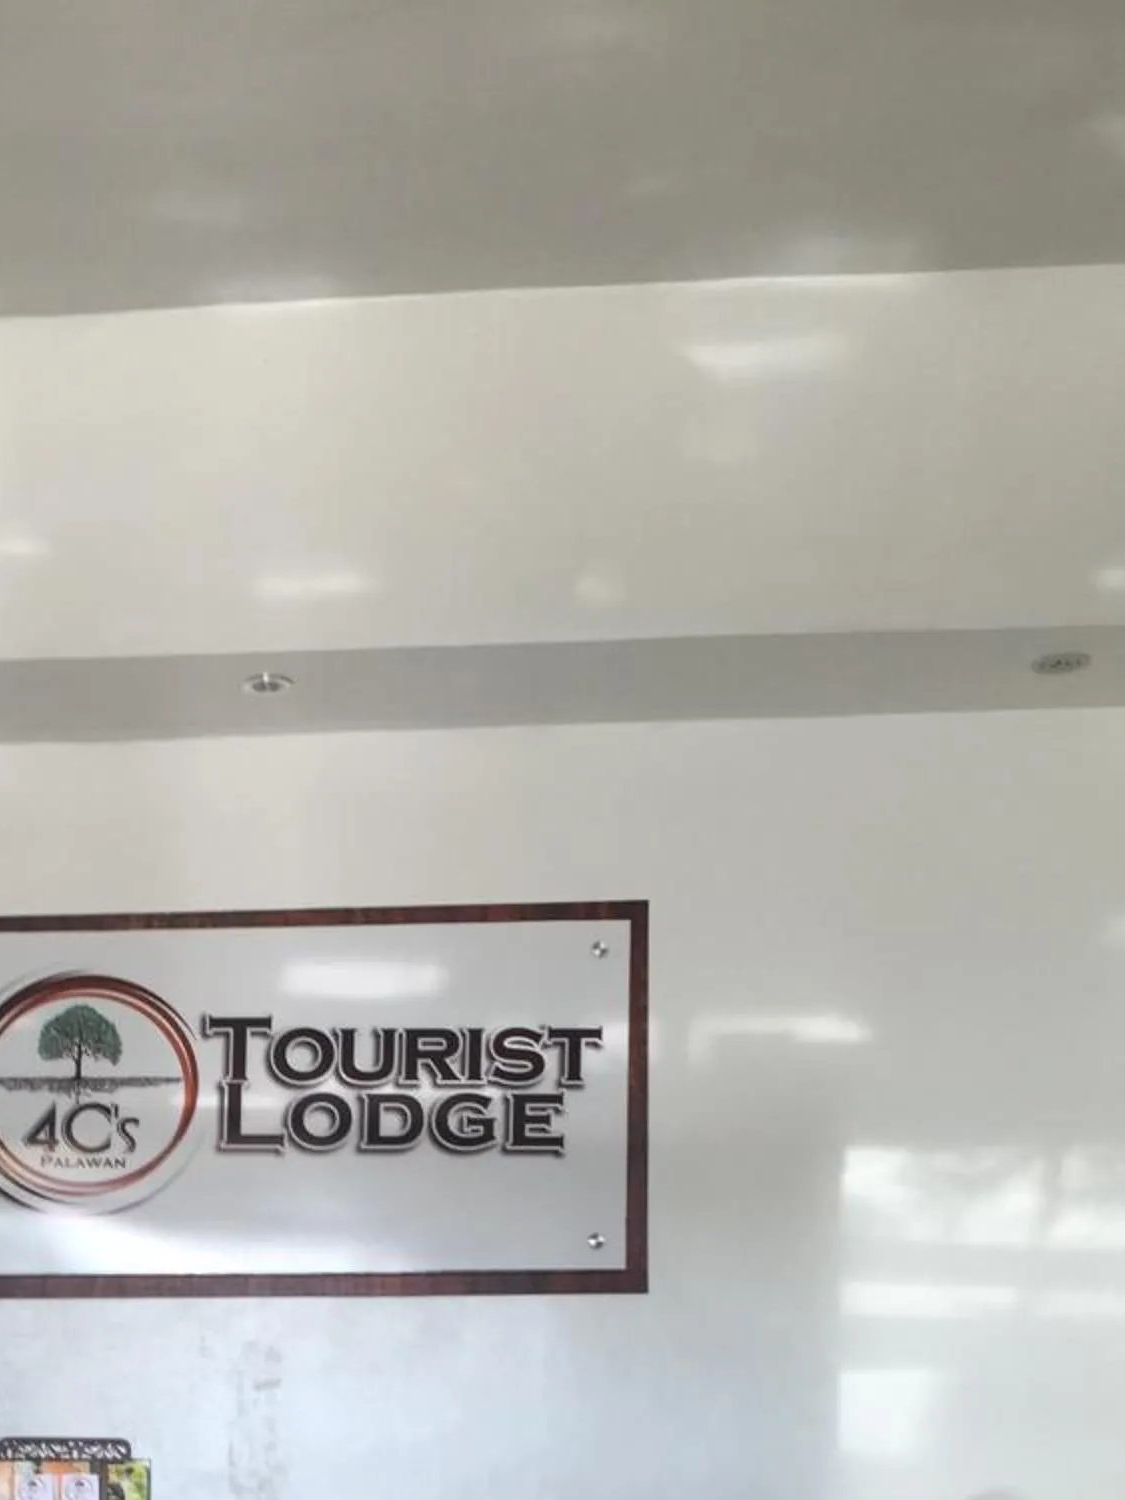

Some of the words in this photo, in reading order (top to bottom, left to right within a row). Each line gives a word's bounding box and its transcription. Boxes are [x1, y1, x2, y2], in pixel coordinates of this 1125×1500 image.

[205, 1014, 603, 1087] TOURIST
[23, 1100, 140, 1152] 4C's
[220, 1083, 566, 1153] LODGE
[40, 1156, 126, 1168] PALAWAN
